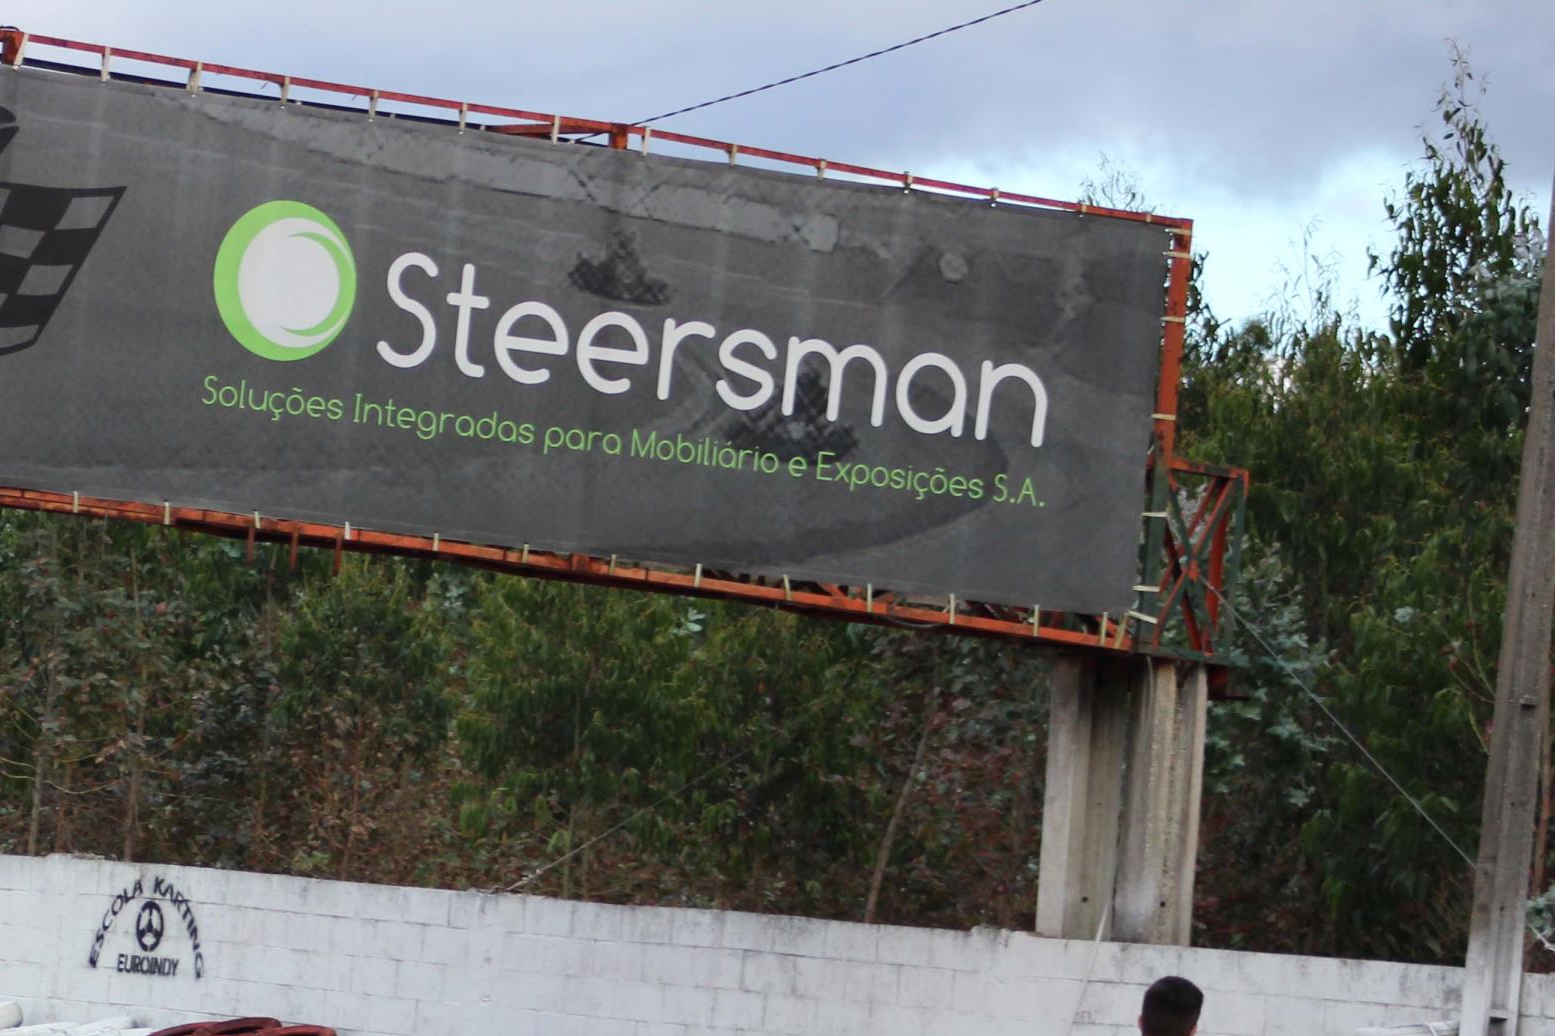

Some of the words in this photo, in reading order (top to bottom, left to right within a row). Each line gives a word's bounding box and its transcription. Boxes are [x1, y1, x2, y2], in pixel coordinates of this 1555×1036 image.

[377, 252, 1047, 448] Steersman
[204, 375, 344, 421] Soluções
[354, 393, 534, 445] Integradas
[544, 425, 622, 455] para
[632, 430, 778, 475] Mobiliário
[788, 456, 807, 478] e
[817, 450, 985, 501] Exposições
[992, 473, 1046, 507] S.A.
[89, 880, 143, 968] ESCOLA
[117, 953, 179, 976] EUROINDY
